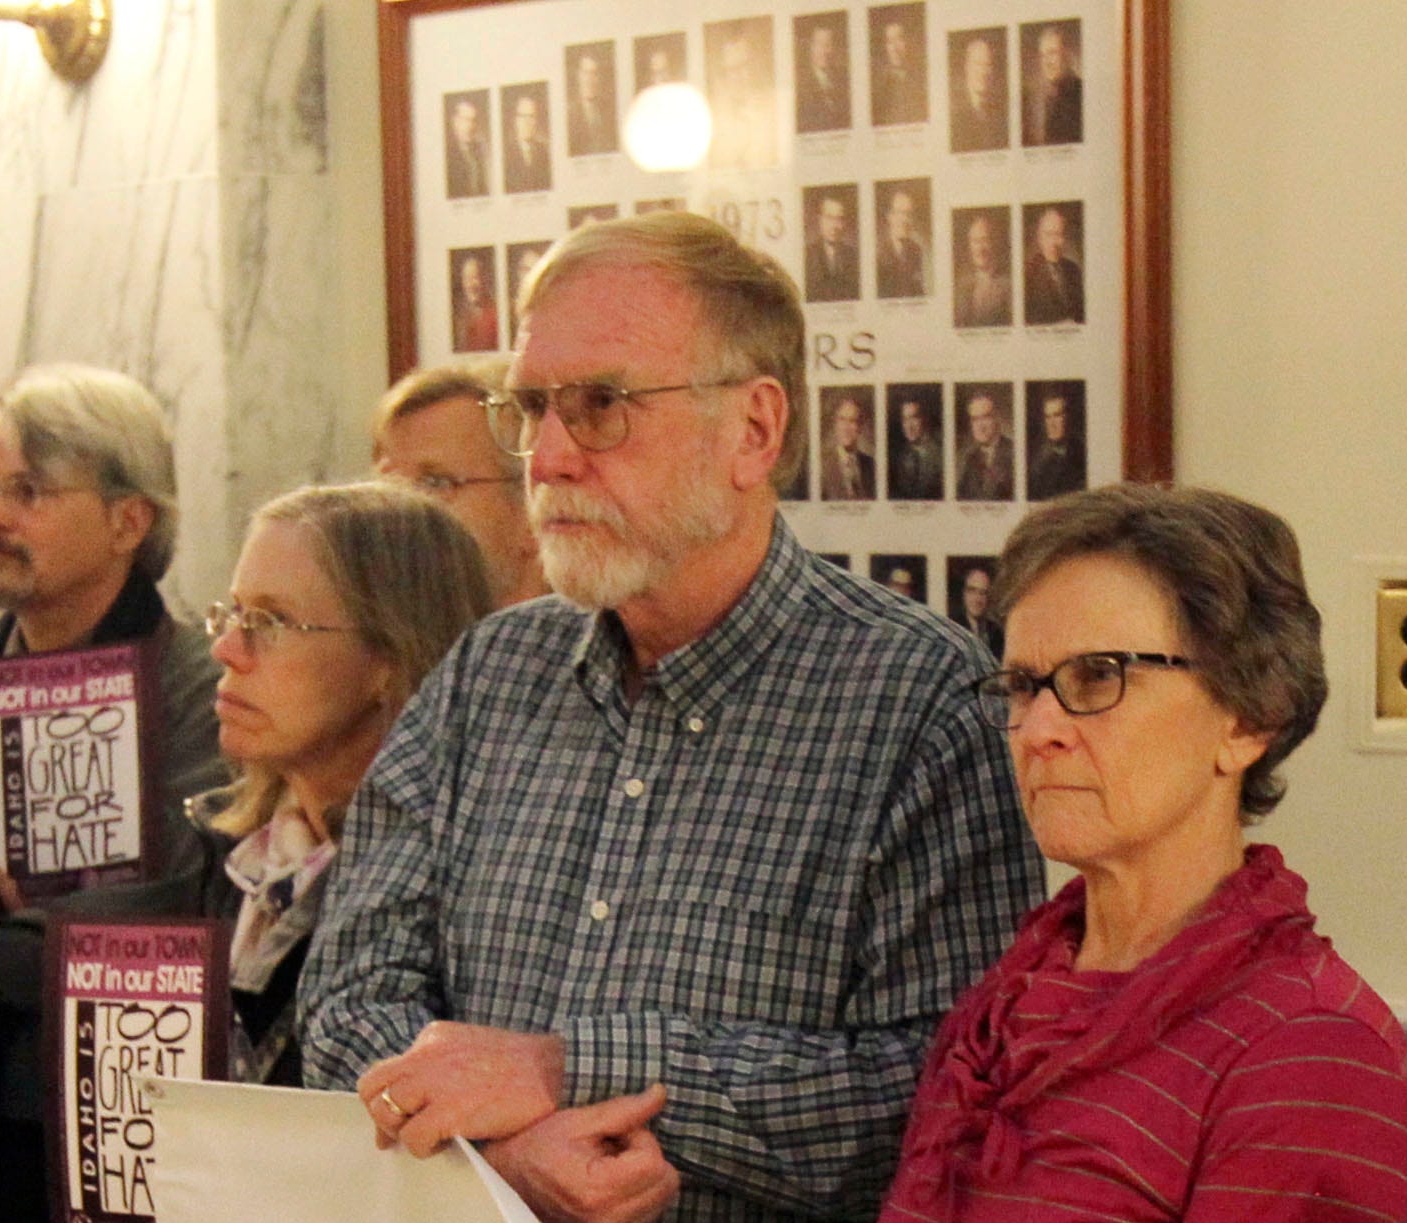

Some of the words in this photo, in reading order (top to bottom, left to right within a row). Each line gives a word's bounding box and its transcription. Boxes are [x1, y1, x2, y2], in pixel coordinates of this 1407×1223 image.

[27, 706, 125, 742] TOO
[27, 735, 119, 795] GREAT
[7, 774, 25, 861] IDAHO
[31, 792, 123, 822] FOR
[31, 817, 126, 872] HATE
[68, 962, 102, 989] NOT
[106, 964, 122, 991] in
[125, 968, 154, 993] our
[157, 965, 204, 995] STATE
[80, 1021, 94, 1057] IS
[98, 1002, 191, 1043] TOO
[80, 1078, 98, 1193] IDAHO
[101, 1117, 155, 1150] FO
[102, 1155, 156, 1213] HA
